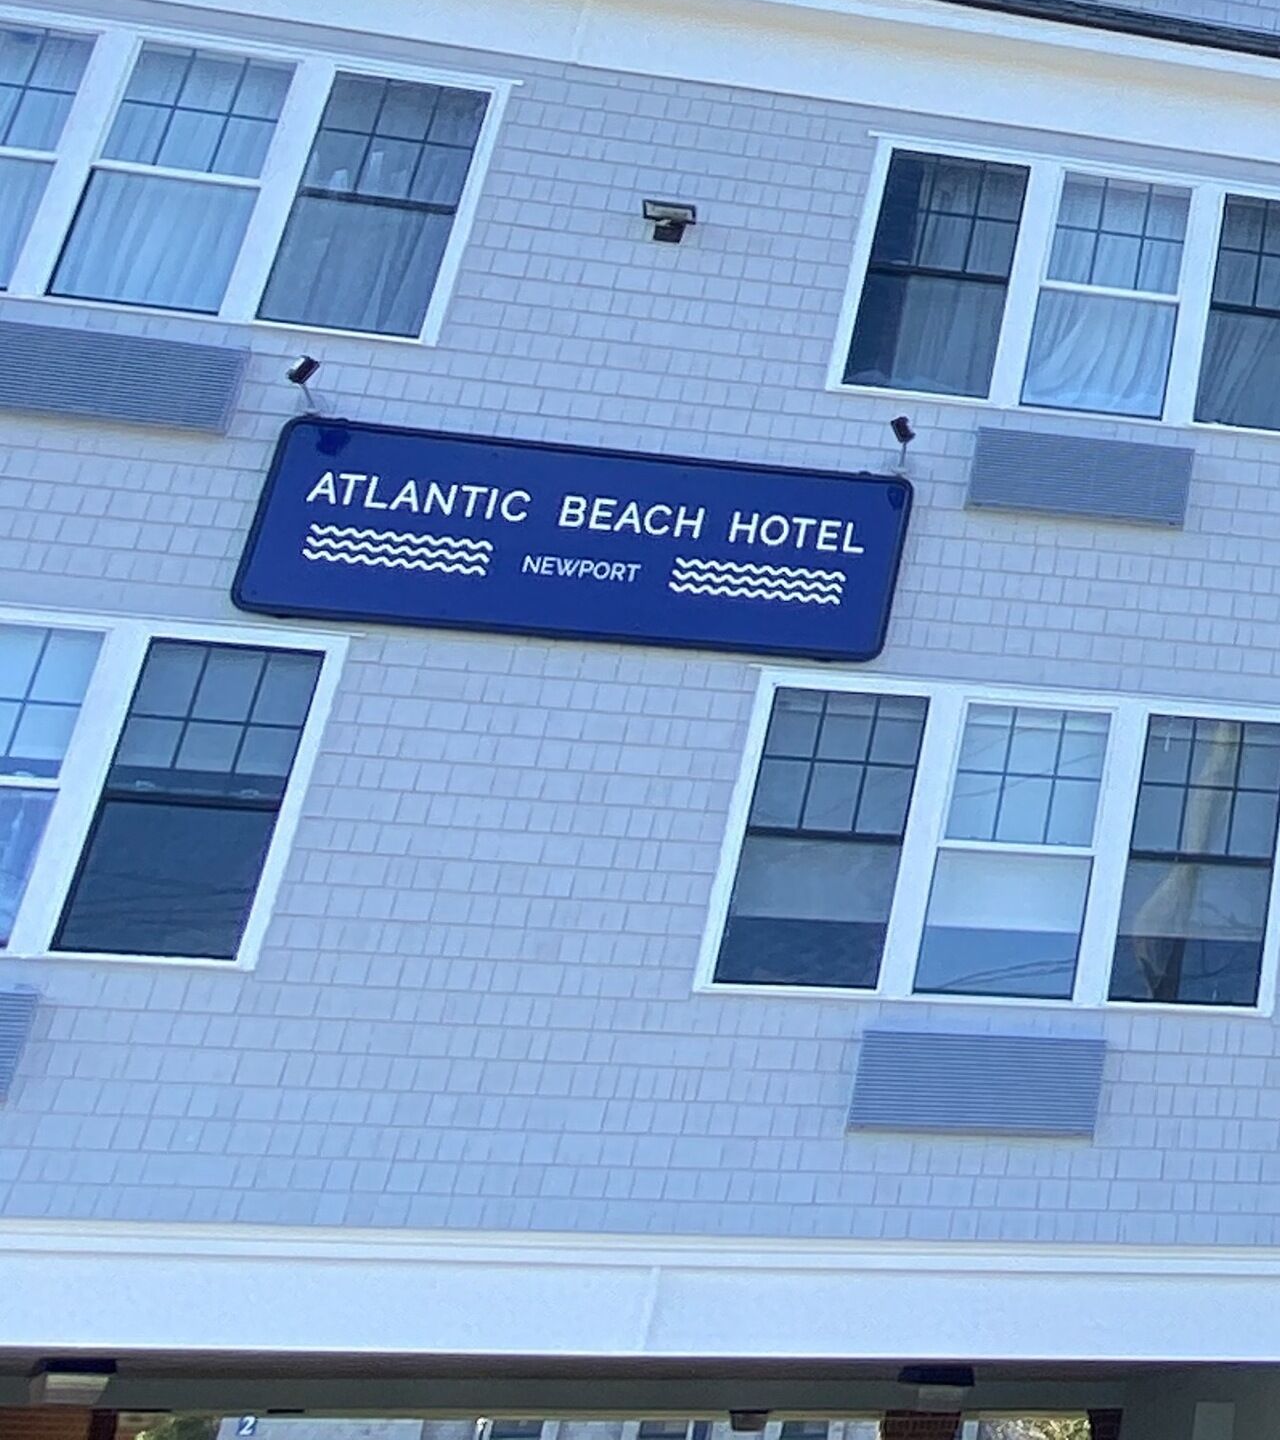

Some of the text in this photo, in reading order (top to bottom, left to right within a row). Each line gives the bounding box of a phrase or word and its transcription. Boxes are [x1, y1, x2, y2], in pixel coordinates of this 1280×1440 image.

[306, 471, 865, 555] ATLANTIC BEACH HOTEL
[522, 555, 641, 583] NEWPORT
[239, 1416, 256, 1435] 2
